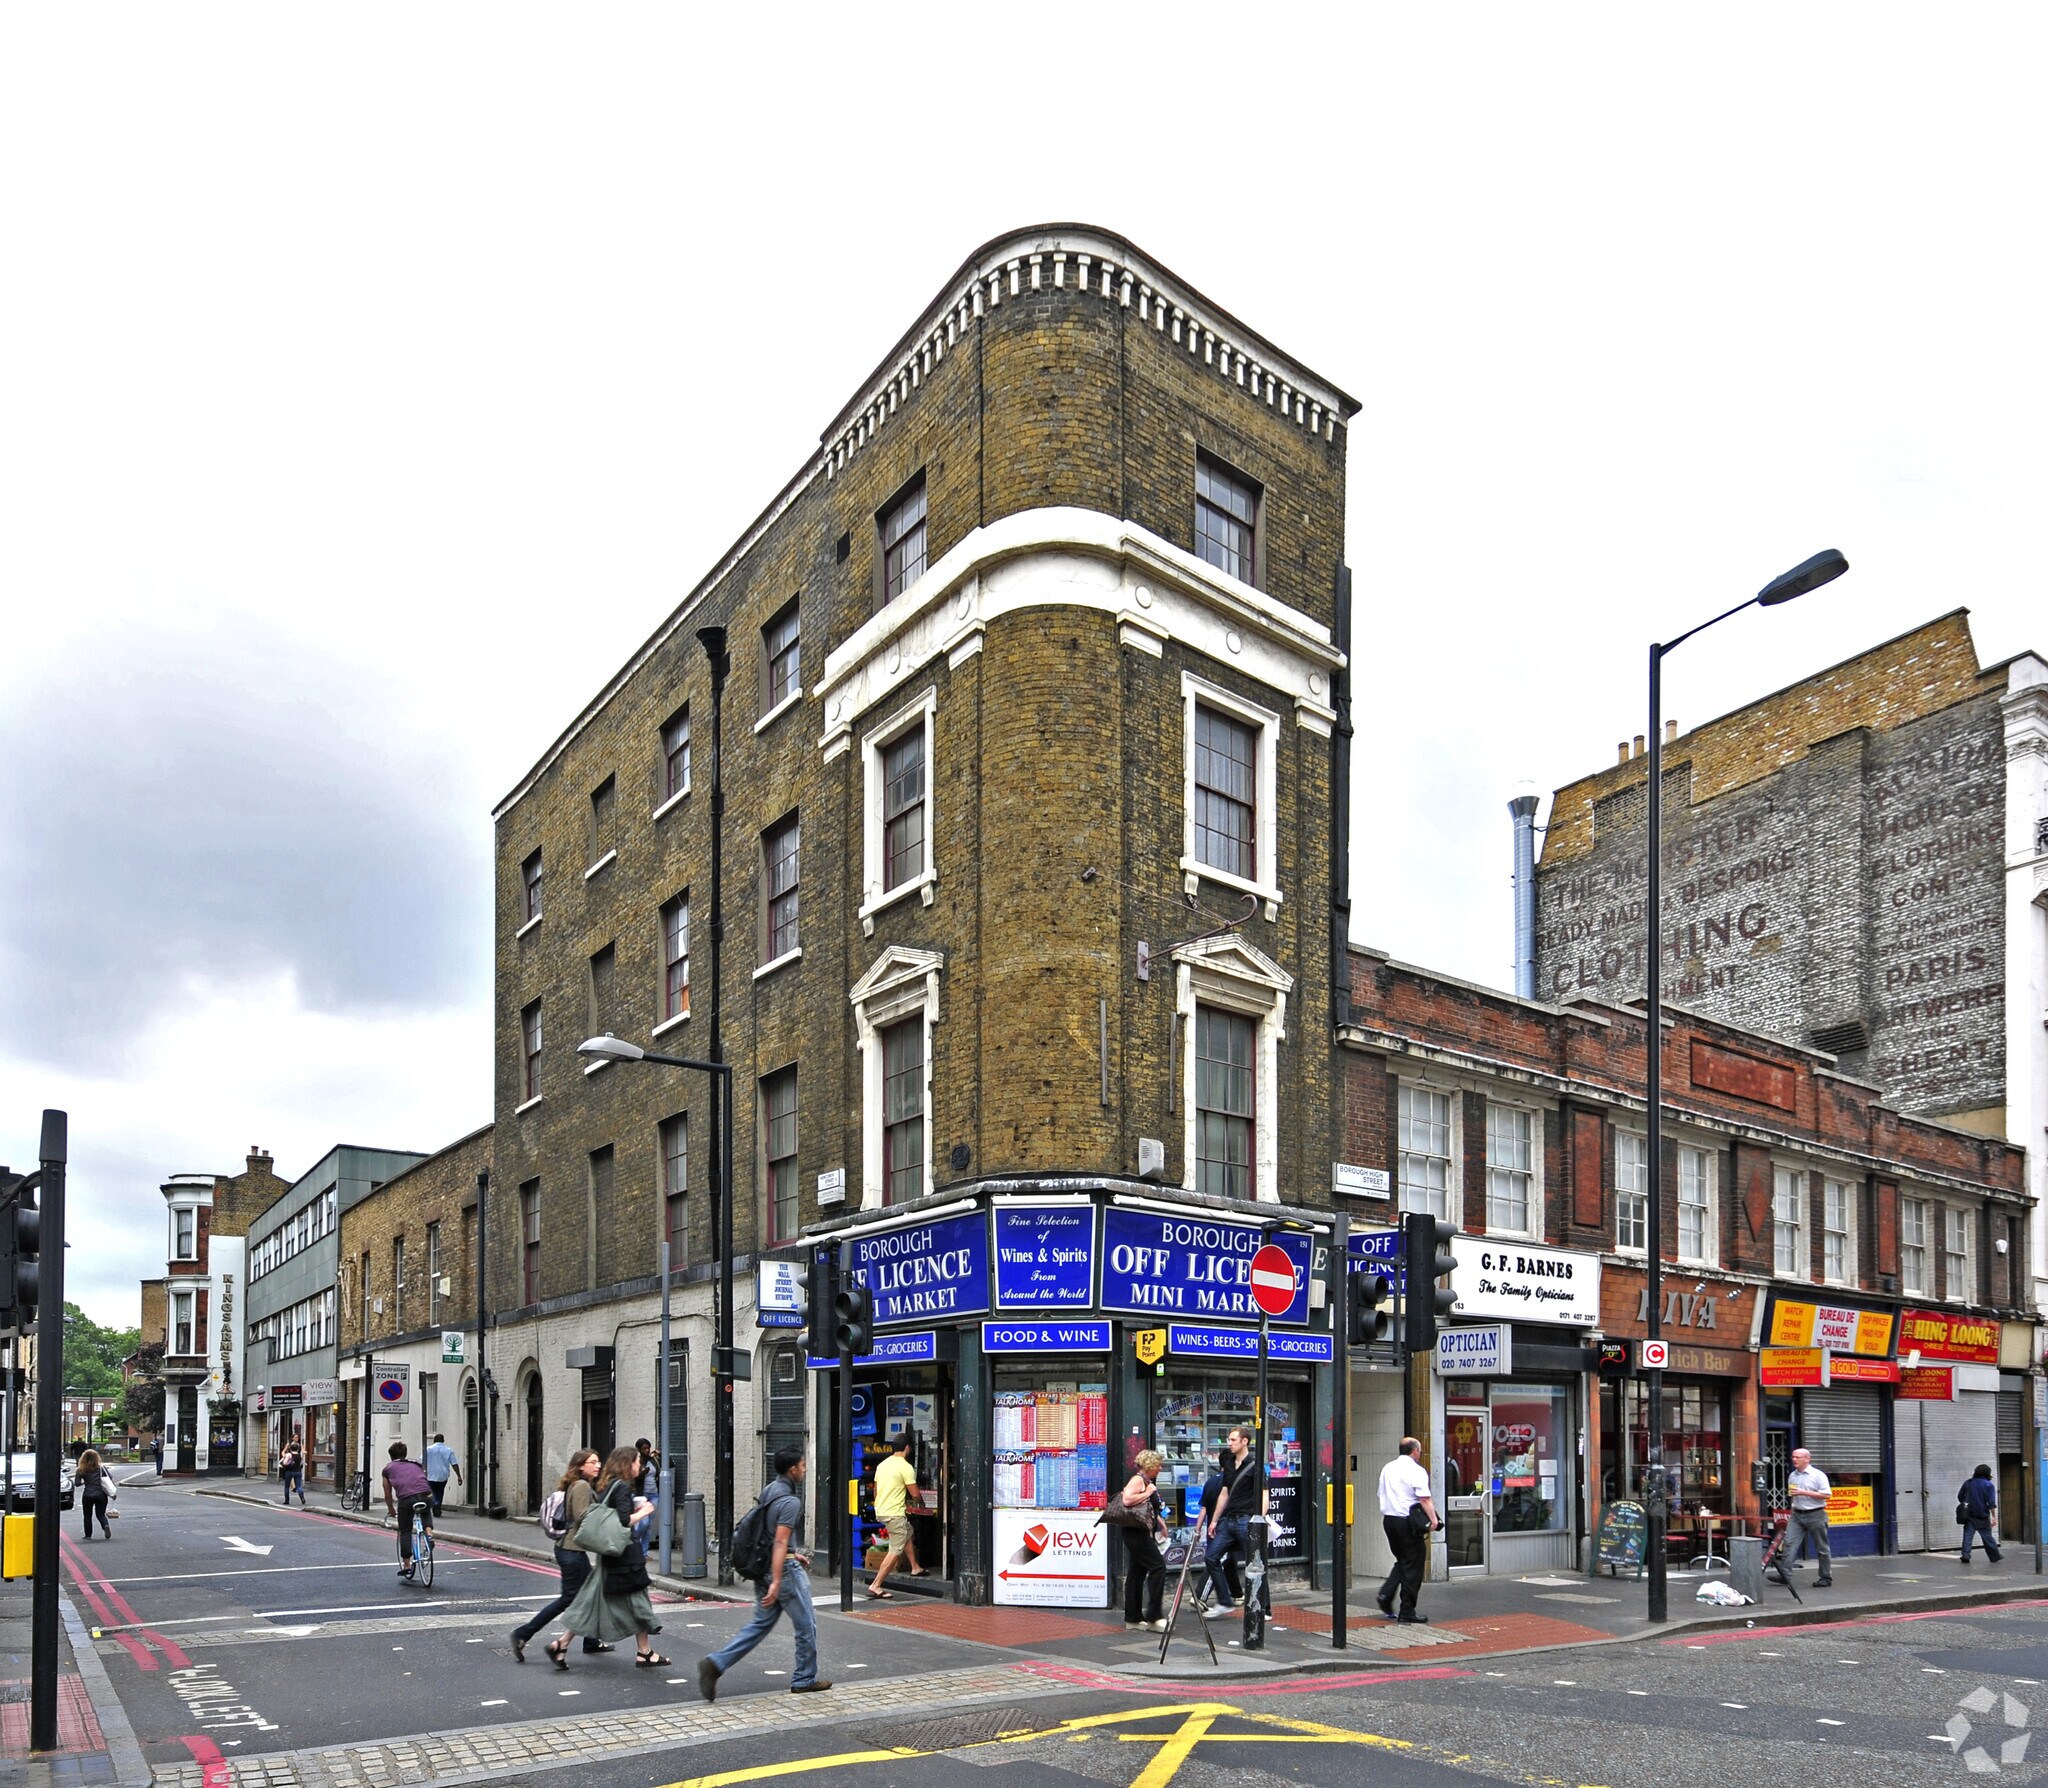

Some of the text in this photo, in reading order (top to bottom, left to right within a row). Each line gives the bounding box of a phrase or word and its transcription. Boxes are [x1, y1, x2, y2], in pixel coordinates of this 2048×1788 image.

[1554, 872, 1601, 910] THE
[1537, 917, 1597, 951] READY
[1682, 848, 1796, 904] BESPOKE
[1553, 902, 1767, 995] CLOTHING
[1340, 1166, 1368, 1175] BOROUGH
[1363, 1176, 1383, 1185] STREET
[1008, 1215, 1080, 1226] Fine Selection
[1037, 1230, 1050, 1244] of
[1162, 1222, 1261, 1254] BOROUGH
[860, 1229, 933, 1262] BOROUGH
[1362, 1237, 1392, 1254] OFF
[1001, 1247, 1088, 1266] Wines & Spirits
[778, 1263, 789, 1271] THE
[879, 1249, 972, 1290] LICENCE
[1111, 1244, 1304, 1291] OFF LICEE
[1516, 1256, 1573, 1280] BARNES
[1031, 1269, 1057, 1281] From
[775, 1278, 792, 1286] STREET
[774, 1286, 794, 1294] JOURNAL
[1001, 1287, 1088, 1300] Around the World
[1479, 1279, 1575, 1303] The Family Opticians
[775, 1293, 793, 1301] EUROPE
[888, 1286, 957, 1316] MARKET
[1131, 1283, 1261, 1314] MINI MARK
[1454, 1302, 1464, 1310] 153
[1785, 1306, 1804, 1316] WATCH
[763, 1314, 803, 1325] OFF LICENCE
[1818, 1308, 1855, 1324] BUREAU DE
[1783, 1319, 1802, 1329] REPAIR
[993, 1329, 1100, 1343] FOOD & WINE
[1821, 1324, 1849, 1338] CHANGE
[1914, 1319, 1991, 1347] HING LOONG
[1440, 1332, 1497, 1354] OPTICIAN
[1601, 1343, 1621, 1352] PIAZZA
[1923, 1342, 1945, 1351] CHINESE
[1441, 1358, 1497, 1369] 020 7407 3267
[1703, 1351, 1730, 1371] Bar
[1836, 1361, 1858, 1375] GOLD
[1920, 1369, 1948, 1377] LOONG
[1013, 1398, 1035, 1406] HOME
[1208, 1391, 1244, 1404] WINES
[1013, 1454, 1035, 1462] HOME
[1270, 1487, 1296, 1497] SPIRITS
[1272, 1537, 1297, 1548] DRINKS
[188, 1698, 279, 1731] LEFT
